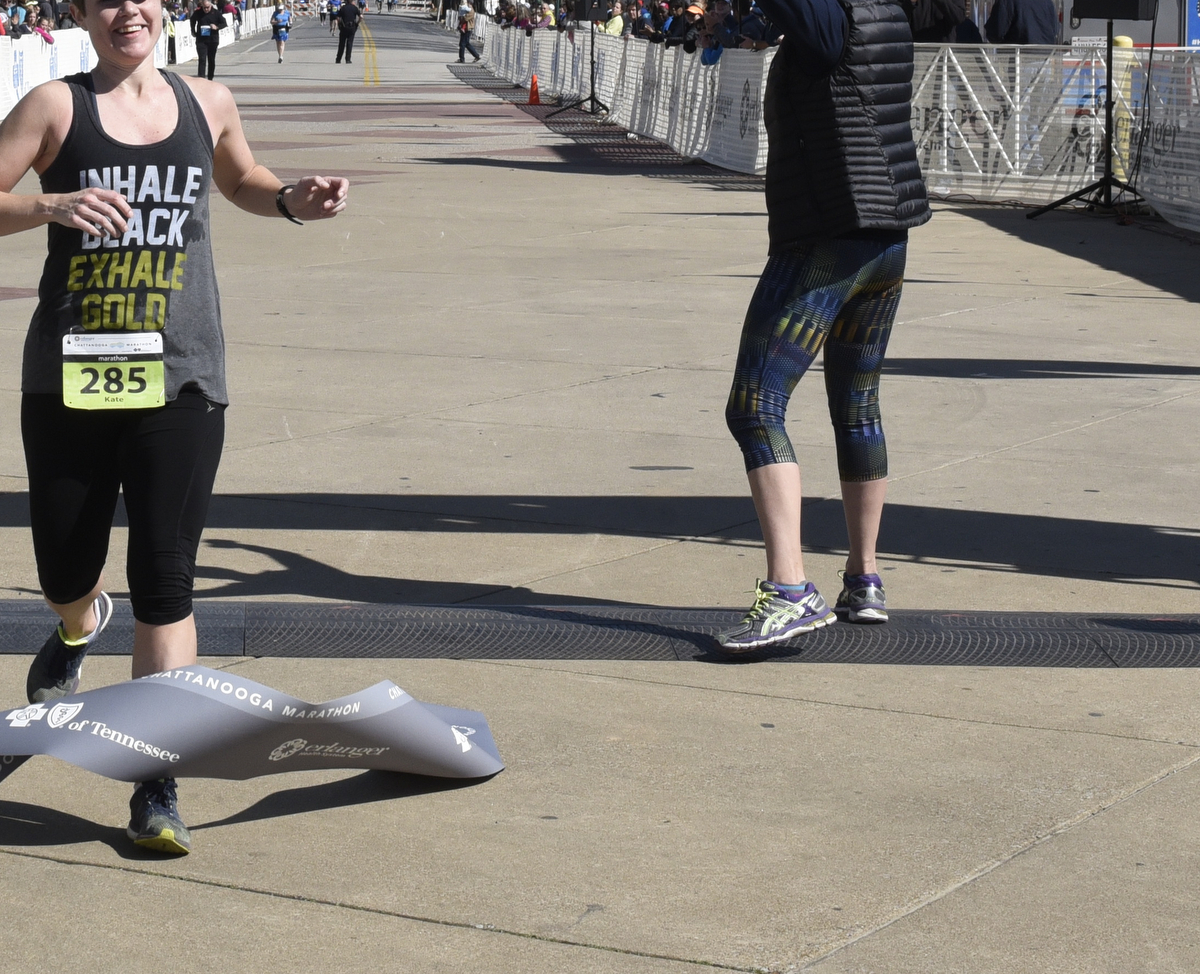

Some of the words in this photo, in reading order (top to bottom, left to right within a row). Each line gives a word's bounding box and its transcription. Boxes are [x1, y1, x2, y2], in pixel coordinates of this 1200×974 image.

[79, 164, 203, 204] INHALE
[66, 250, 187, 292] EXHALE
[81, 292, 167, 330] GOLD
[80, 366, 147, 395] 285
[281, 701, 361, 719] MARATHON
[68, 720, 90, 732] of
[91, 720, 181, 763] Tennessee
[304, 741, 390, 759] erlanger
